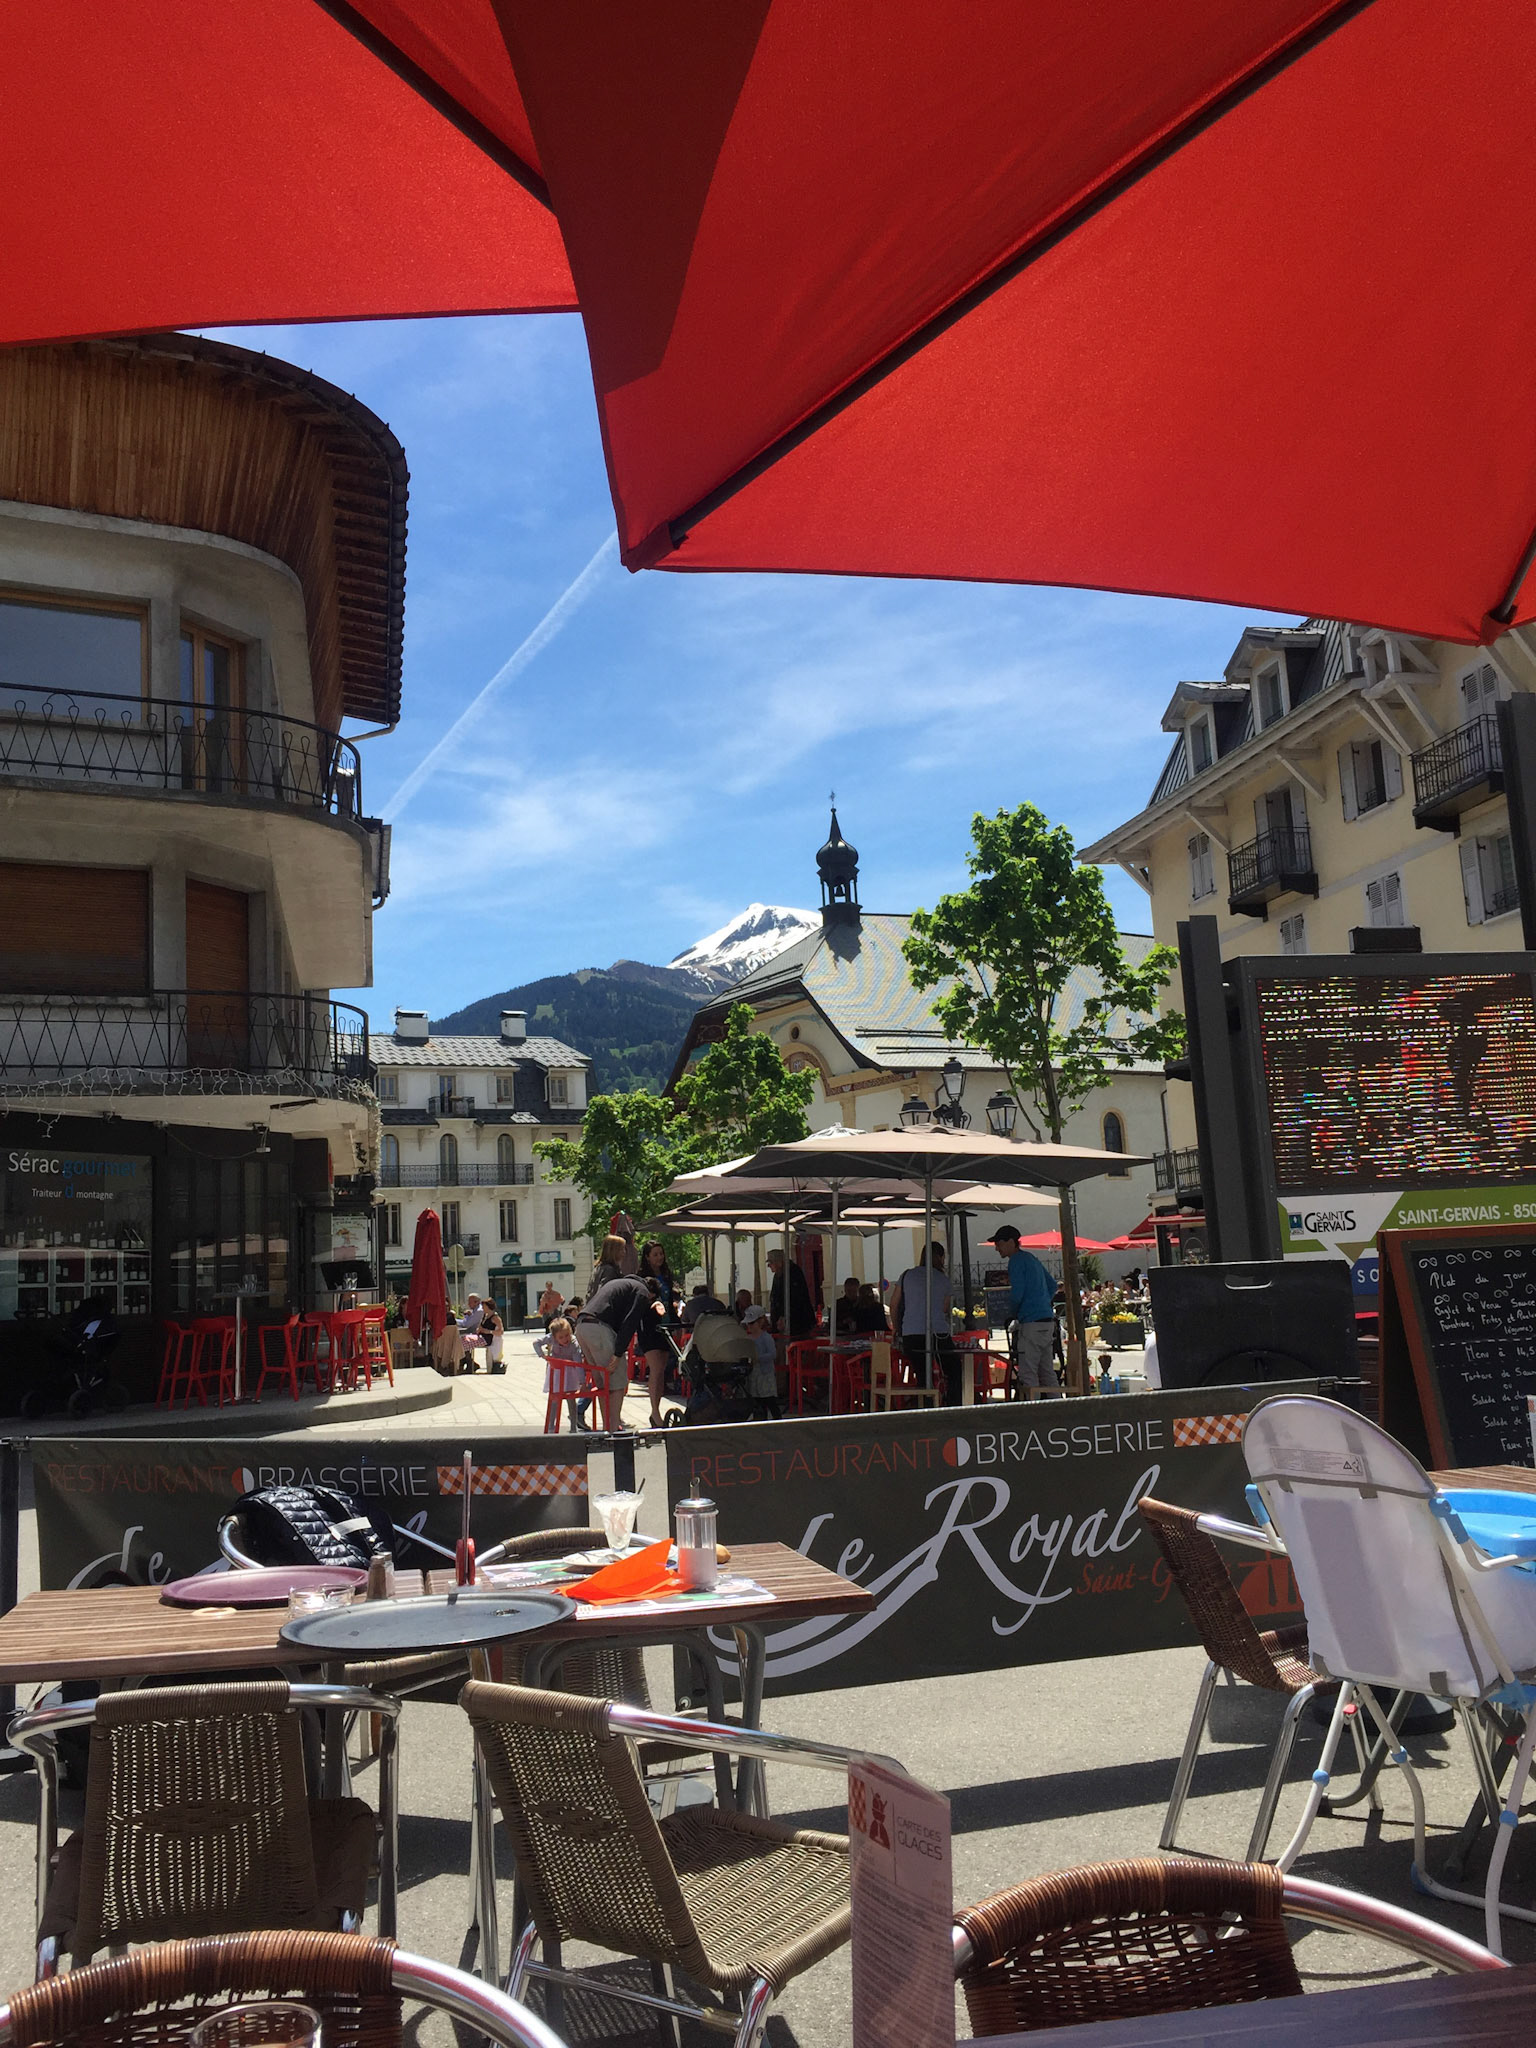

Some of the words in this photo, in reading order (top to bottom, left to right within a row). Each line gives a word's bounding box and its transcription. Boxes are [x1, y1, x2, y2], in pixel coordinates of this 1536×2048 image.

[32, 1188, 62, 1199] Traiteur
[76, 1191, 114, 1201] montagne
[1304, 1210, 1357, 1233] GERVAIS
[1316, 1211, 1344, 1222] SAINT
[1398, 1205, 1501, 1225] SAINT-GERVAIS
[1430, 1272, 1456, 1289] Plat
[1503, 1272, 1527, 1289] Jour
[1465, 1345, 1490, 1362] Menu
[691, 1438, 938, 1488] RESTAURANT
[976, 1419, 1164, 1466] BRASSERIE
[47, 1463, 229, 1494] RESTAURANT
[259, 1466, 430, 1497] BRASSERIE
[924, 1826, 942, 1843] DES
[898, 1830, 943, 1861] GLACES
